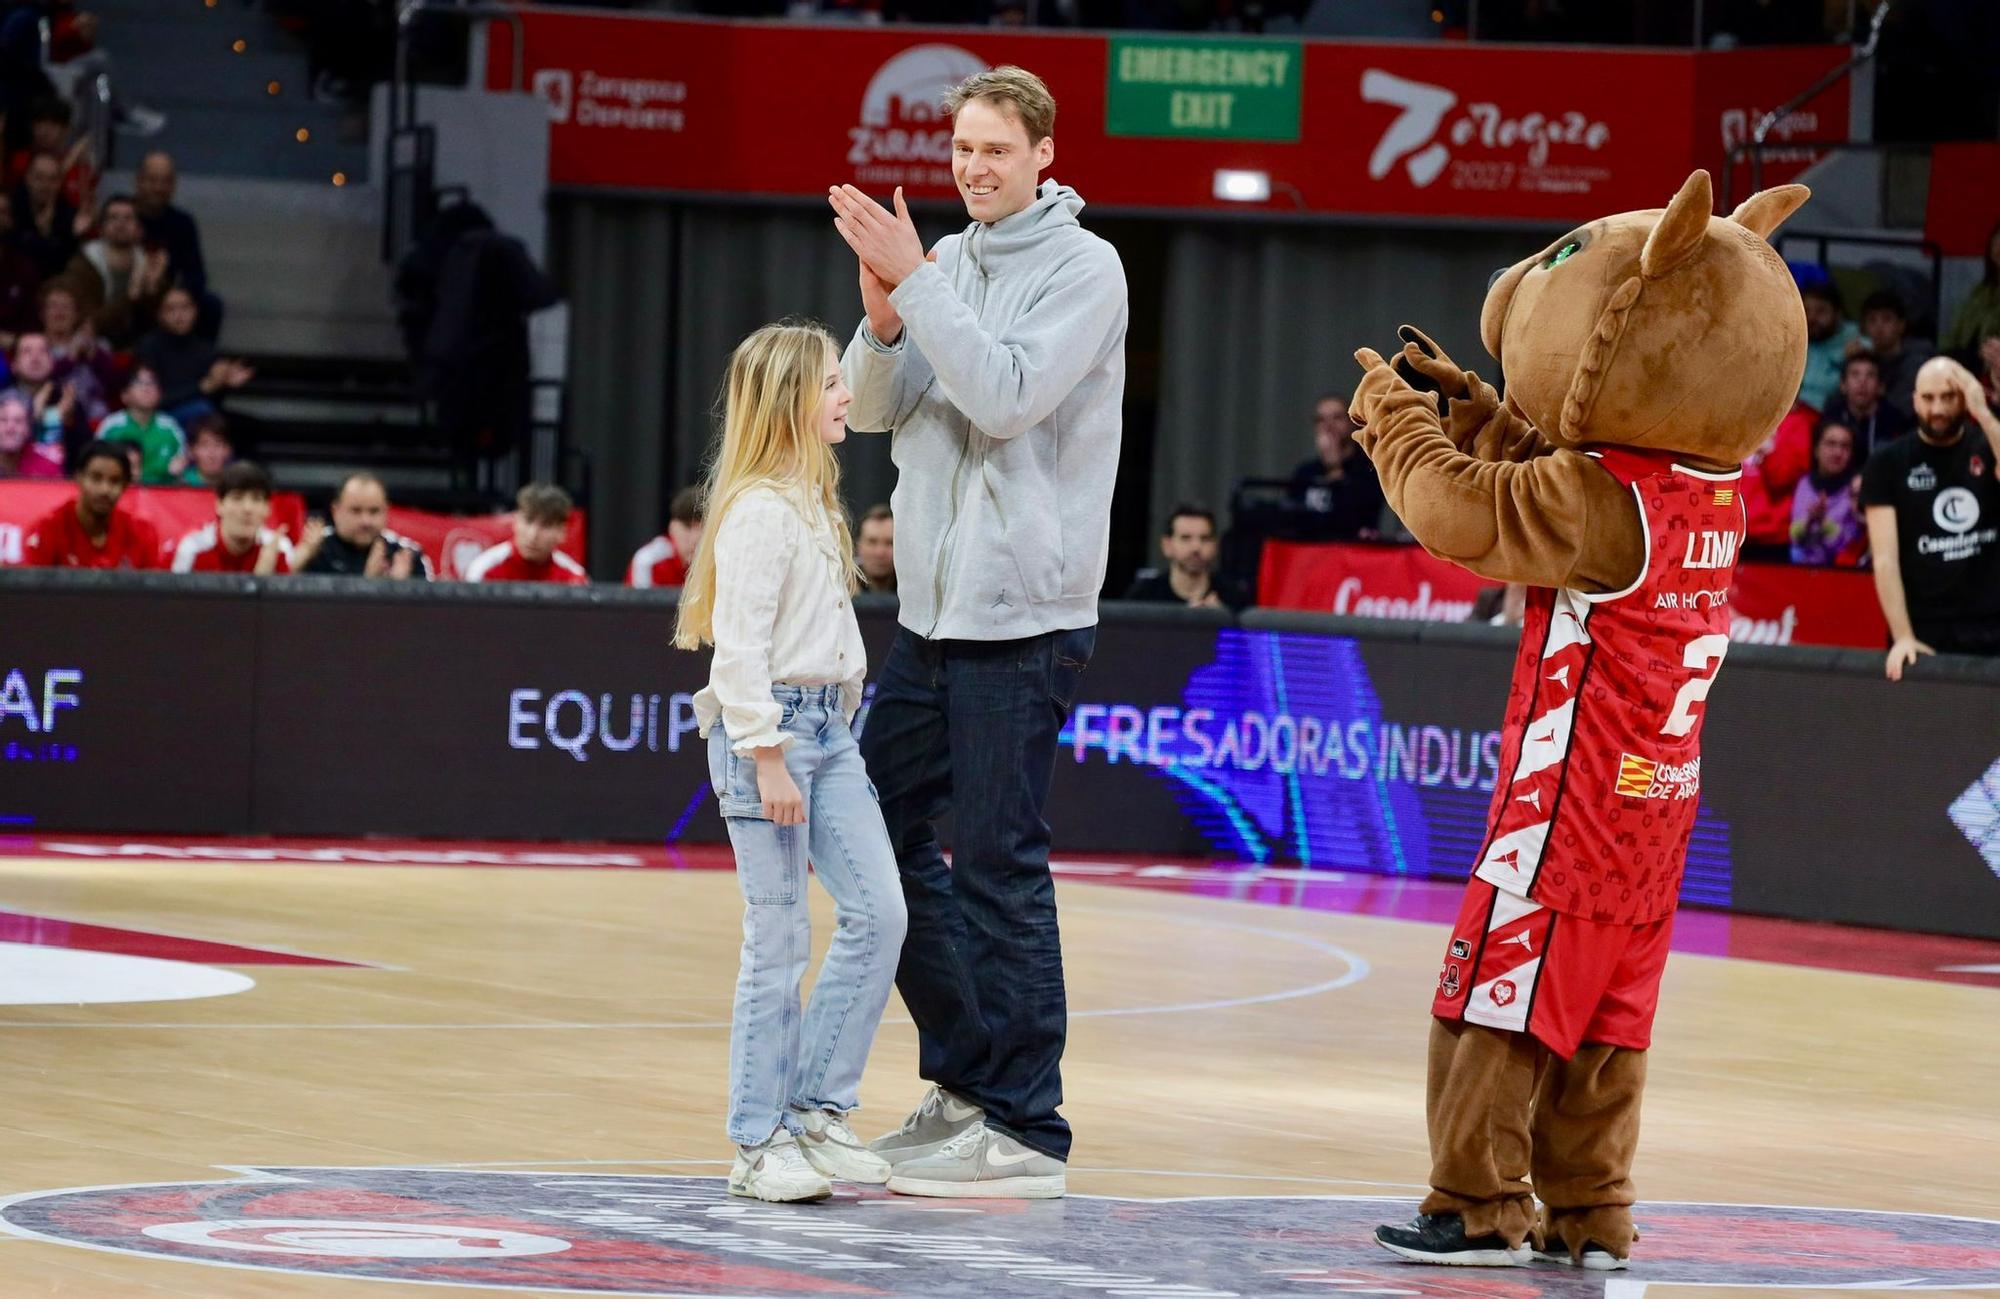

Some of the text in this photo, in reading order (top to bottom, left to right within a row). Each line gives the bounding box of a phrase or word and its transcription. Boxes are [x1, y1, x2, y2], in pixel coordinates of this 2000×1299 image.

[1119, 46, 1289, 87] EMERGENCY
[1170, 90, 1235, 129] EXIT
[846, 127, 958, 163] ZARAG
[1654, 592, 1679, 609] AIR
[1658, 633, 1730, 737] 2
[509, 686, 1502, 792] EQUIP FRESADORAS INDUS
[1648, 783, 1675, 800] DE
